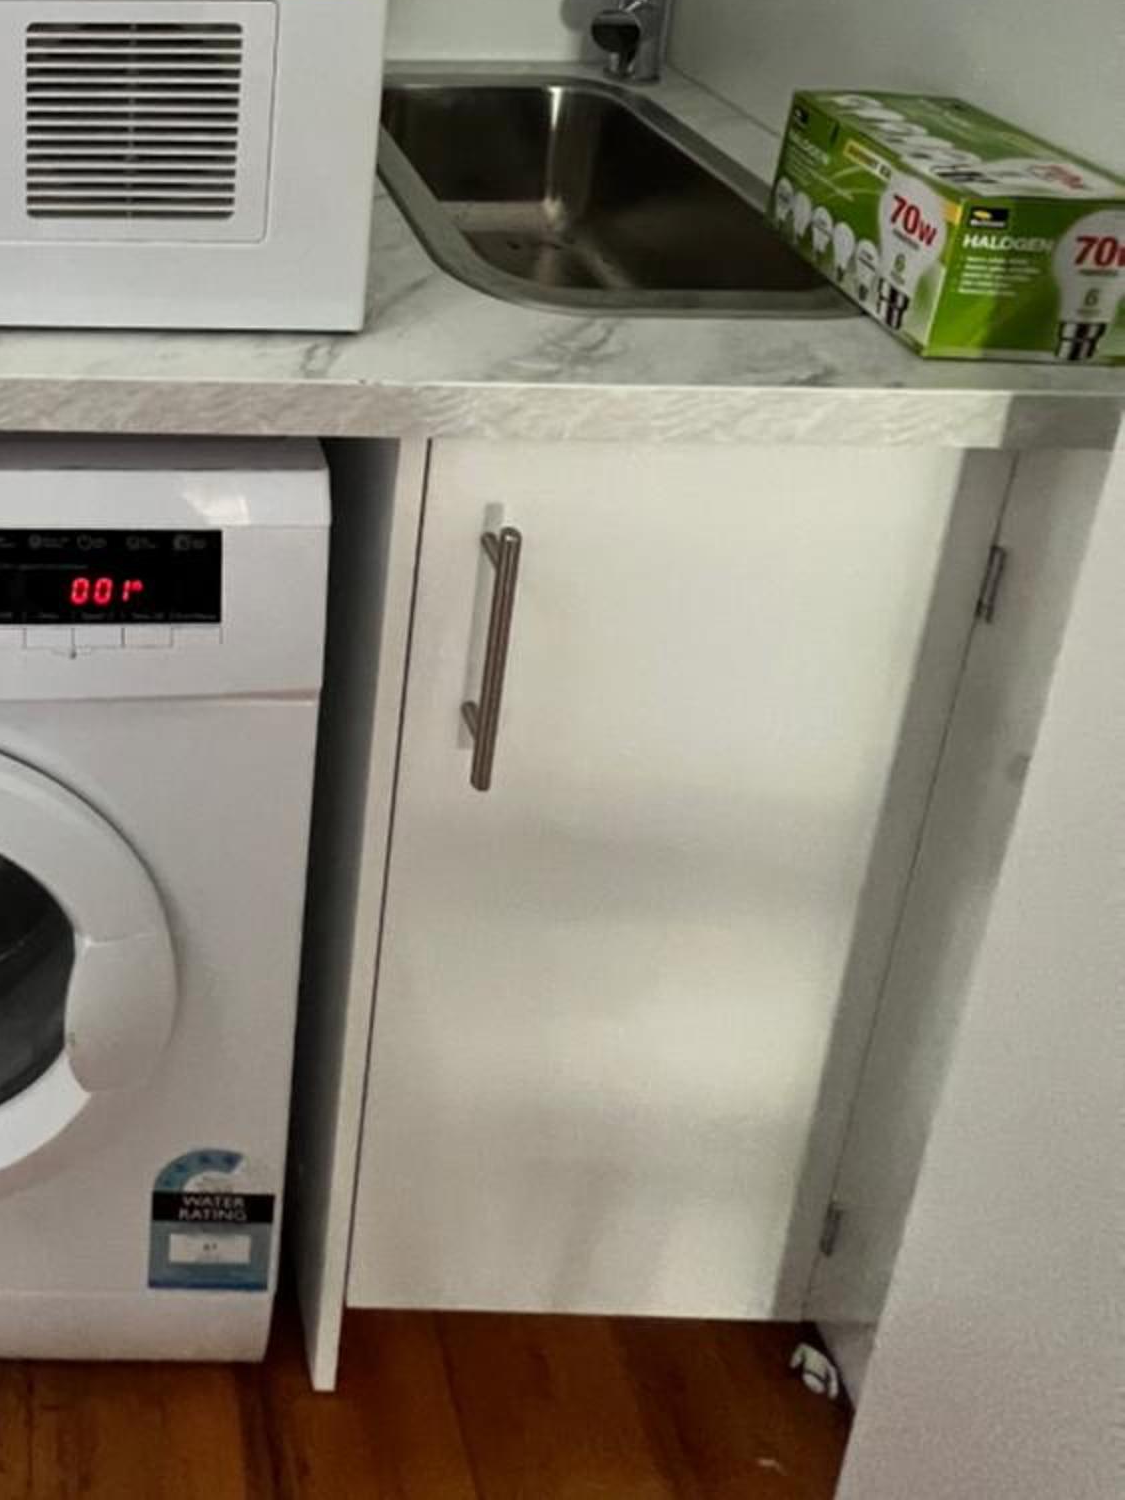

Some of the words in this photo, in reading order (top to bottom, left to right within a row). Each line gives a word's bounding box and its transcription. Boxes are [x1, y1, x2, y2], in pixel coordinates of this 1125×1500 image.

[1084, 288, 1099, 307] 6
[183, 1196, 245, 1207] WATER
[178, 1209, 248, 1221] RATING
